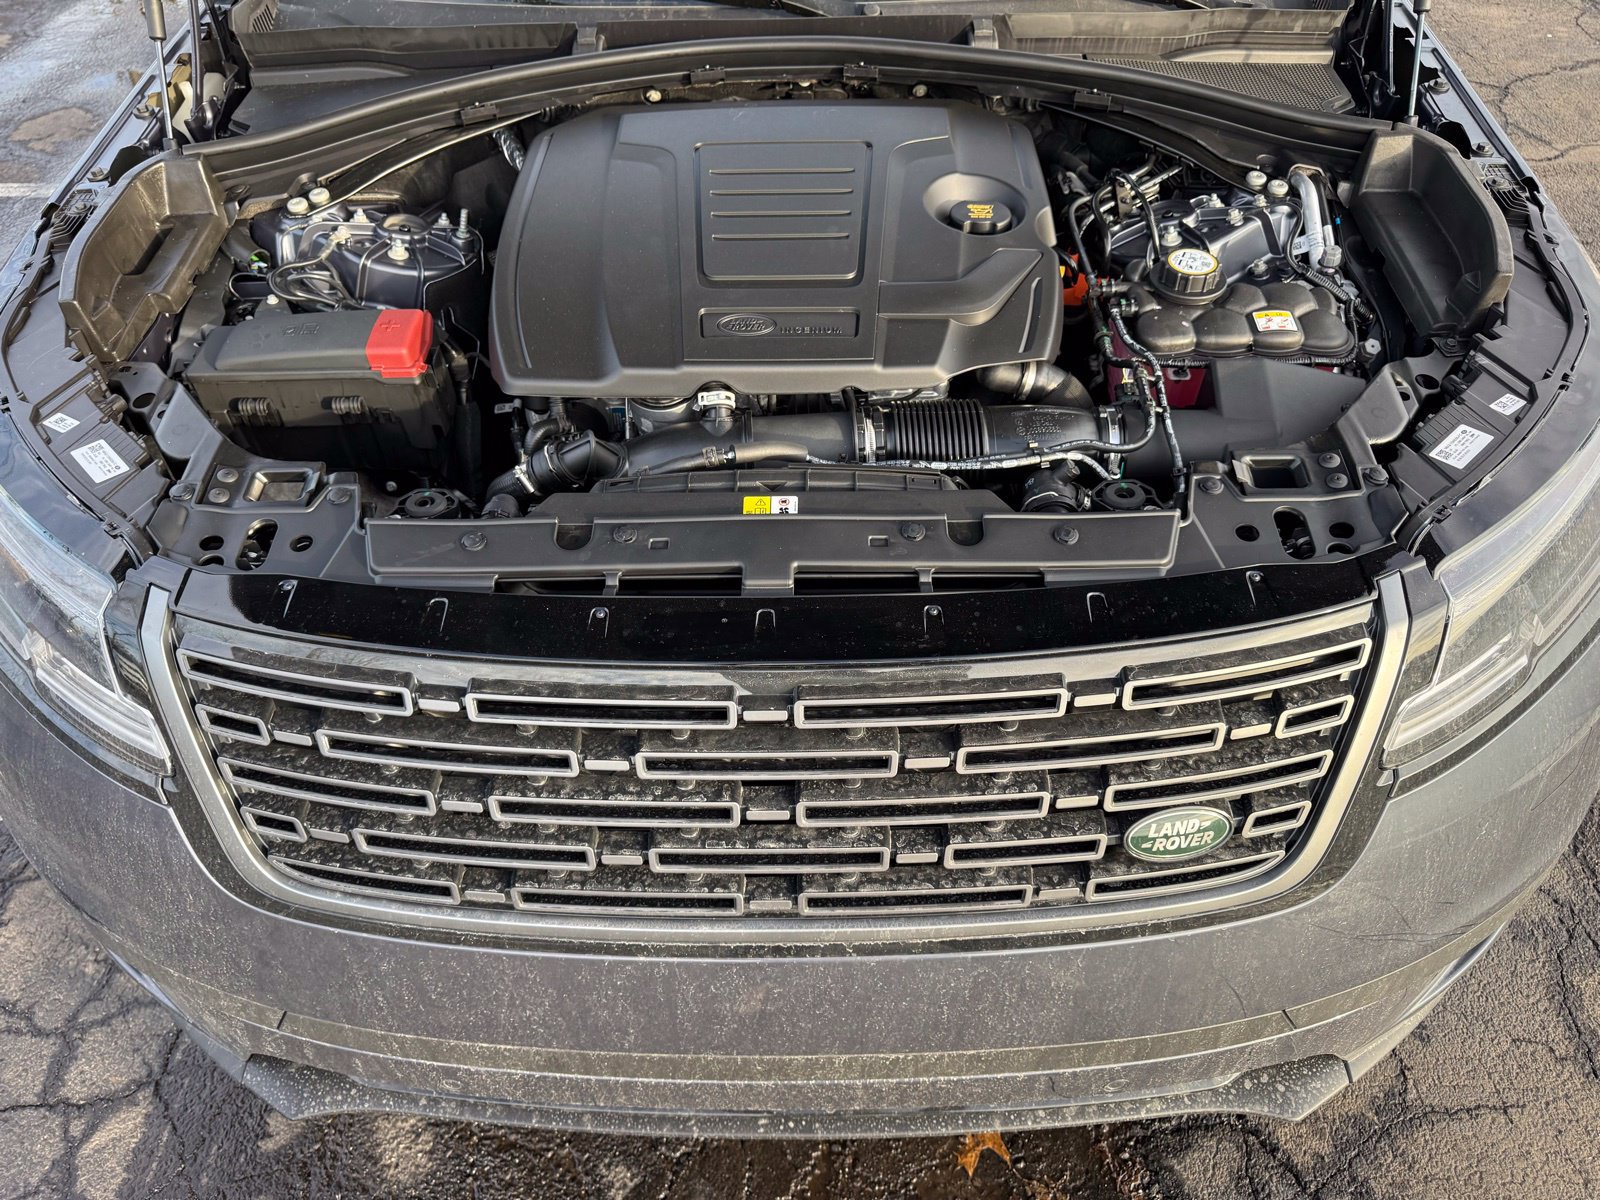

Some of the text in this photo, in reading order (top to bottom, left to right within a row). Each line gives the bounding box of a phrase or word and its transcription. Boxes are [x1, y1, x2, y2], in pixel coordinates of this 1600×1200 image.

[731, 322, 766, 331] ROVER
[779, 326, 843, 334] INGENIUM
[1148, 818, 1200, 838] LAND
[1152, 831, 1215, 852] ROVER
